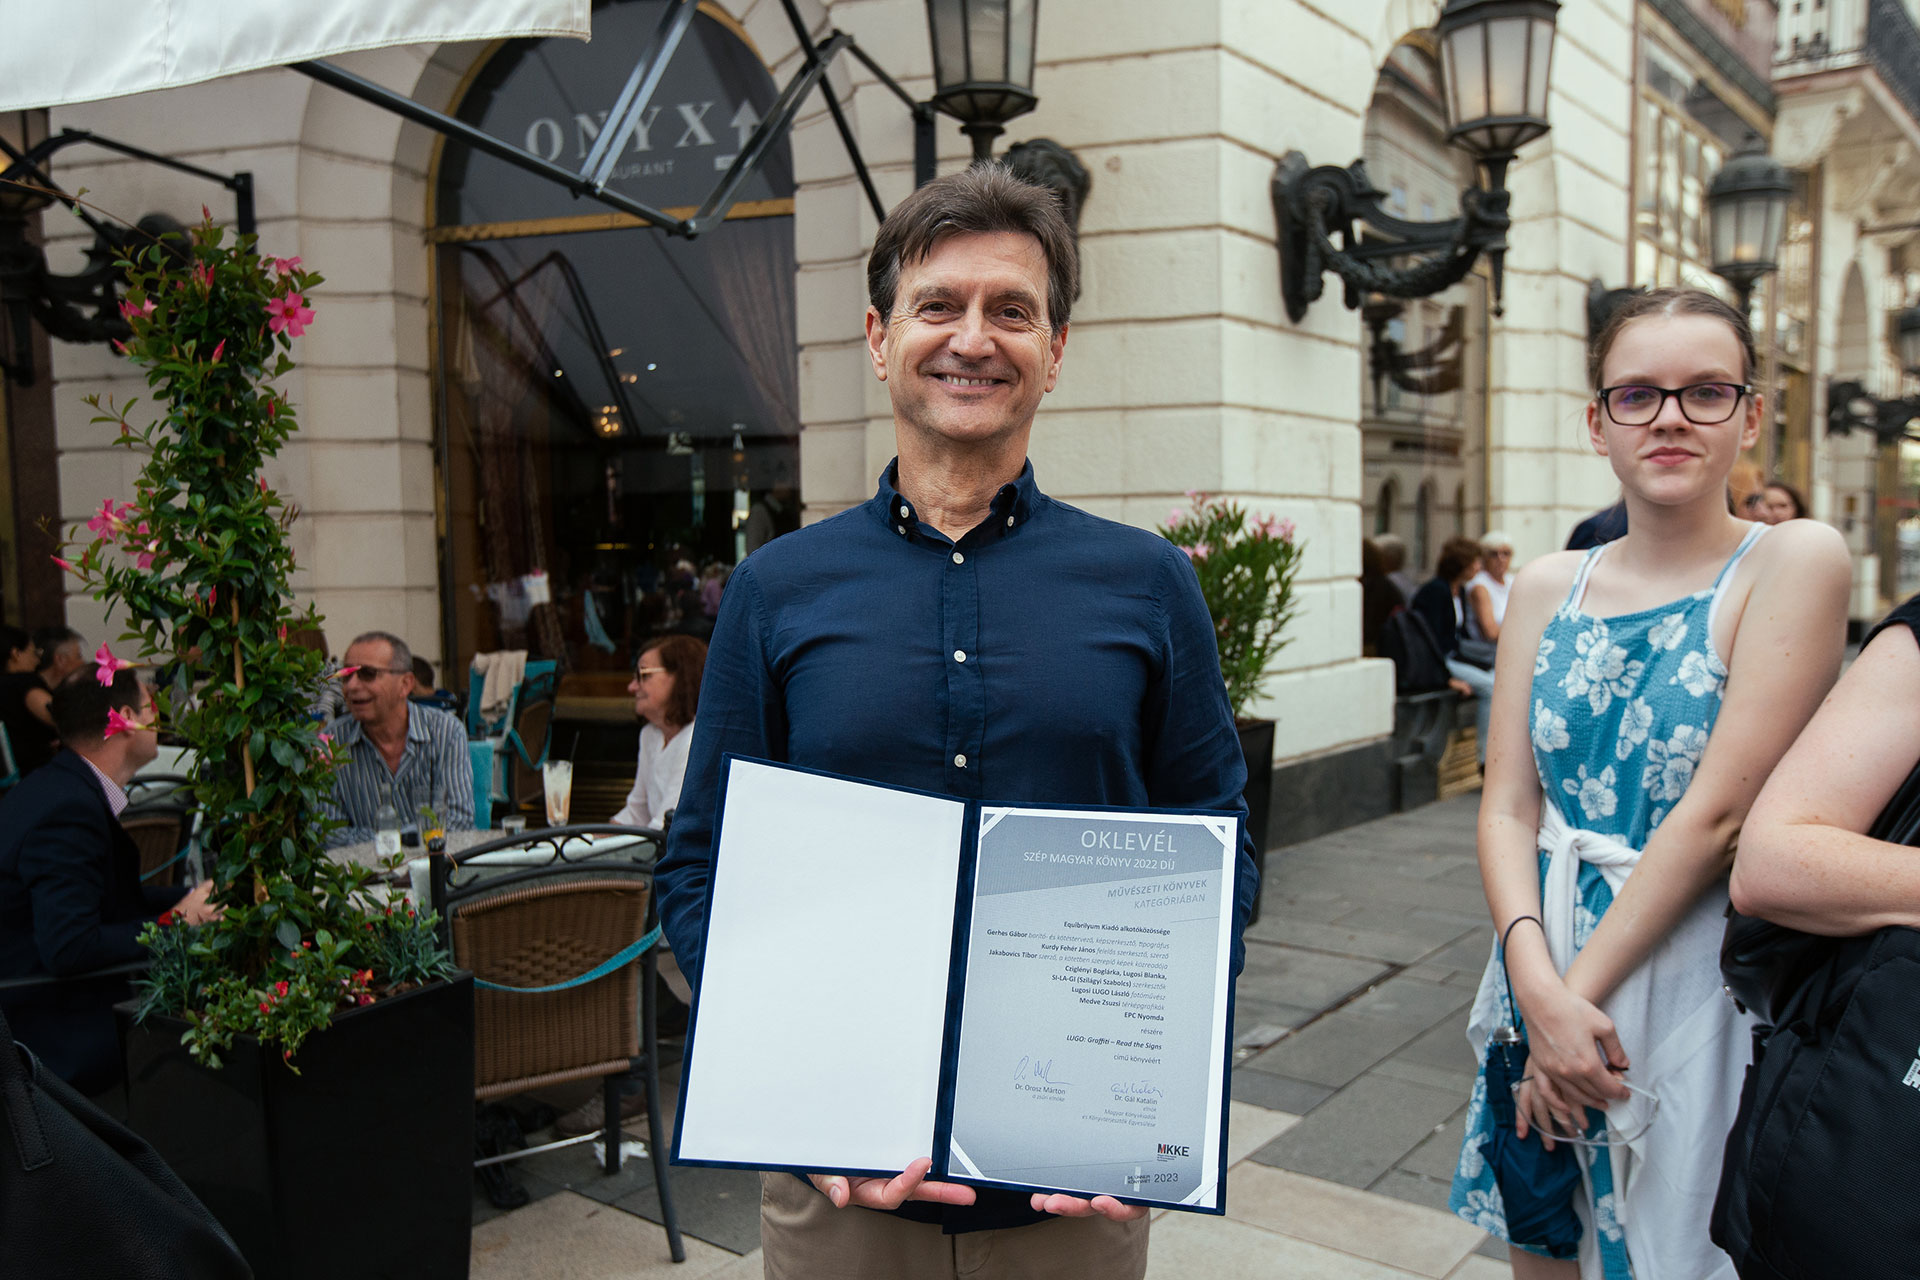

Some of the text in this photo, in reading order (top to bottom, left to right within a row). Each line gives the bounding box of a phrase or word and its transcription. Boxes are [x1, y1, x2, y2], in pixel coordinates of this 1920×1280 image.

[525, 102, 717, 163] ONYX
[610, 160, 675, 181] AURANT
[1081, 829, 1178, 854] OKLEVÉL
[1023, 850, 1176, 871] SZÉP MAGYAR KÖNYV 2022 DÍJ
[1107, 879, 1208, 898] MŰVÉSZETI KÖNYVEK
[1133, 893, 1206, 909] KATEGÓRIÁBAN
[987, 928, 1008, 937] Gerhes
[1009, 930, 1028, 939] Gábor
[1049, 933, 1056, 941] és
[1101, 924, 1119, 932] Kiadó
[1120, 925, 1171, 936] alkotóközössége
[989, 949, 1021, 958] Jakabovics
[1022, 950, 1038, 959] Tibor
[1116, 959, 1133, 968] képek
[1041, 943, 1059, 952] Kurdy
[1060, 944, 1078, 952] Fehér
[1078, 946, 1096, 954] János
[1150, 951, 1169, 960] szerző
[1065, 965, 1167, 981] Cziglényi Boglárka, Lugosi Blanka,
[1051, 974, 1076, 983] SI-LA-GI
[1077, 976, 1102, 986] (Szilágyi
[1102, 978, 1132, 989] Szabolcs)
[1071, 986, 1091, 995] Lugosi
[1092, 987, 1110, 996] LUGO
[1111, 989, 1130, 998] László
[1079, 997, 1101, 1006] Medve
[1101, 999, 1121, 1008] Zsuzsi
[1124, 1011, 1164, 1022] EPC Nyomda
[1140, 1028, 1163, 1036] részére
[1066, 1034, 1086, 1043] LUGO:
[1087, 1036, 1110, 1046] Graffiti
[1116, 1039, 1132, 1048] Read
[1133, 1041, 1145, 1049] the
[1145, 1042, 1162, 1051] Signs
[1130, 1055, 1161, 1066] könyvéért
[1015, 1083, 1066, 1096] Dr. Orosz Márton
[1124, 1094, 1135, 1103] Gál
[1136, 1096, 1158, 1106] Katalin
[1157, 1142, 1190, 1158] MKKE
[1153, 1172, 1180, 1184] 2023
